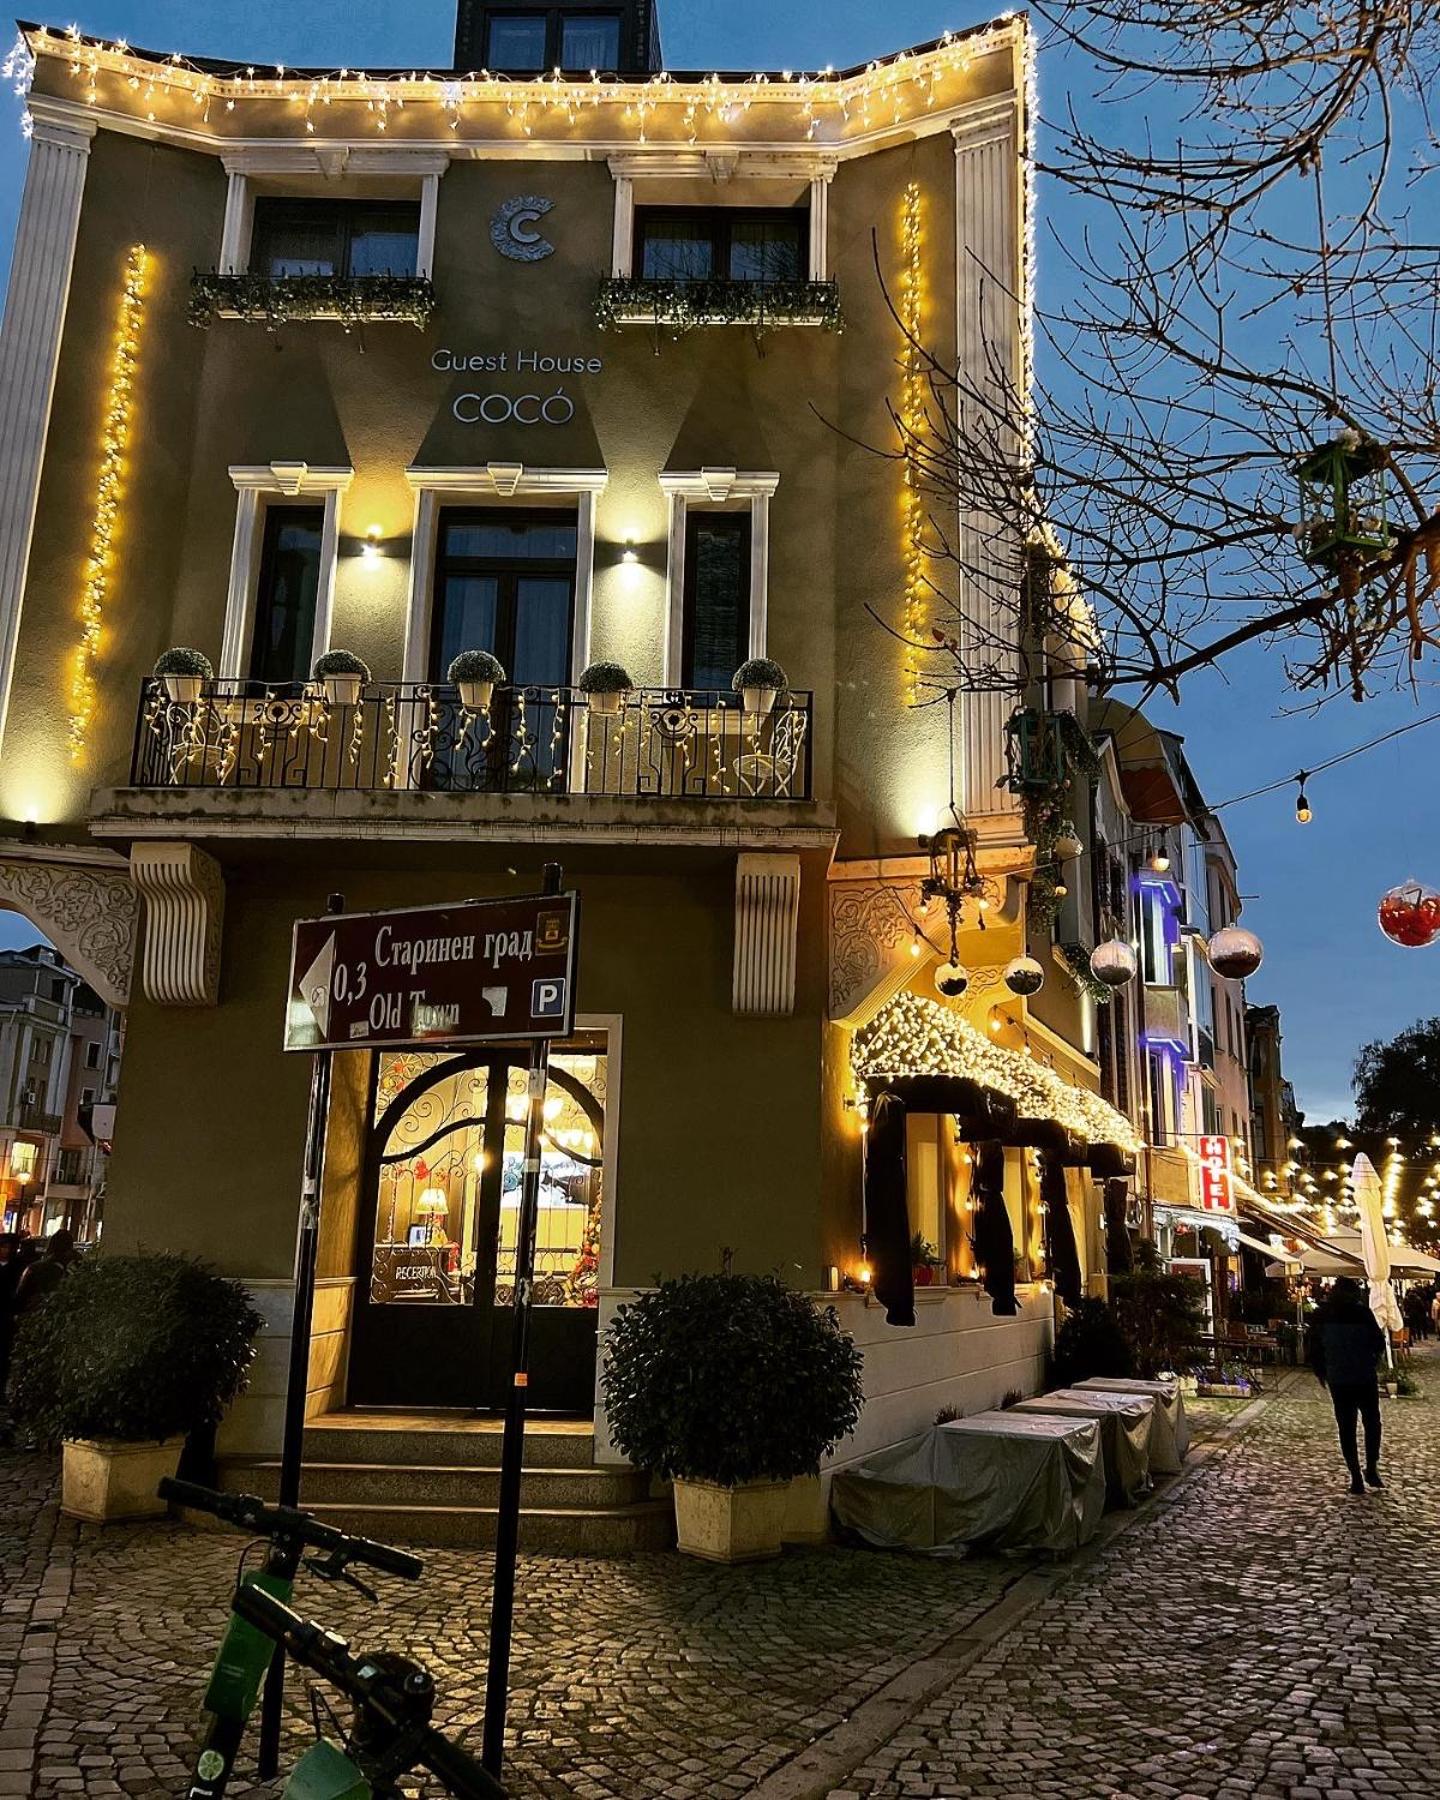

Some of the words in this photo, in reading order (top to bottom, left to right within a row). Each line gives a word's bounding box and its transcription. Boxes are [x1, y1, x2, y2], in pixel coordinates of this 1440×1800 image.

[431, 349, 508, 372] Guest
[517, 351, 602, 373] House
[453, 386, 574, 424] COCÓ
[375, 925, 476, 975] Старинен
[483, 930, 533, 969] град
[333, 962, 367, 1006] 0,3
[539, 984, 558, 1012] P
[369, 992, 402, 1030] Old
[409, 990, 460, 1028] Town
[1205, 1138, 1226, 1209] HOTEL
